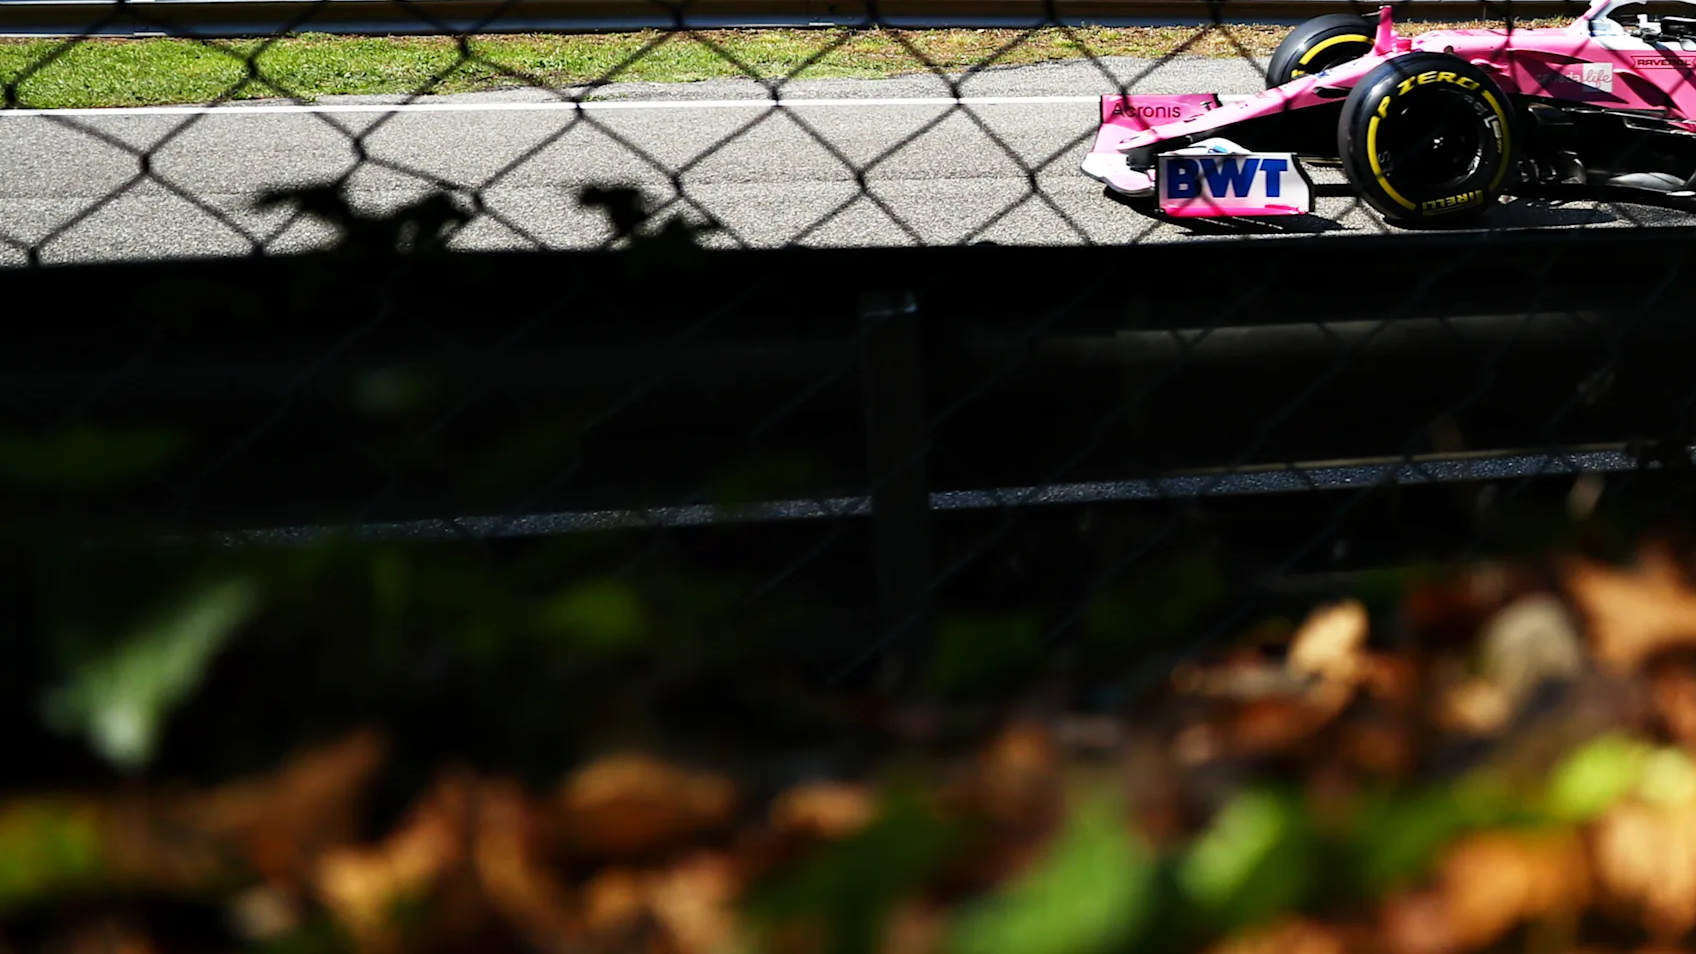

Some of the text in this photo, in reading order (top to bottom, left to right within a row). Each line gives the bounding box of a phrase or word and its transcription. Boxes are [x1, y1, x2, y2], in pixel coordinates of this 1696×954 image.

[1583, 68, 1613, 89] life
[1377, 71, 1480, 119] P ZERO
[1112, 103, 1181, 119] Acronis
[1166, 158, 1288, 199] BWT
